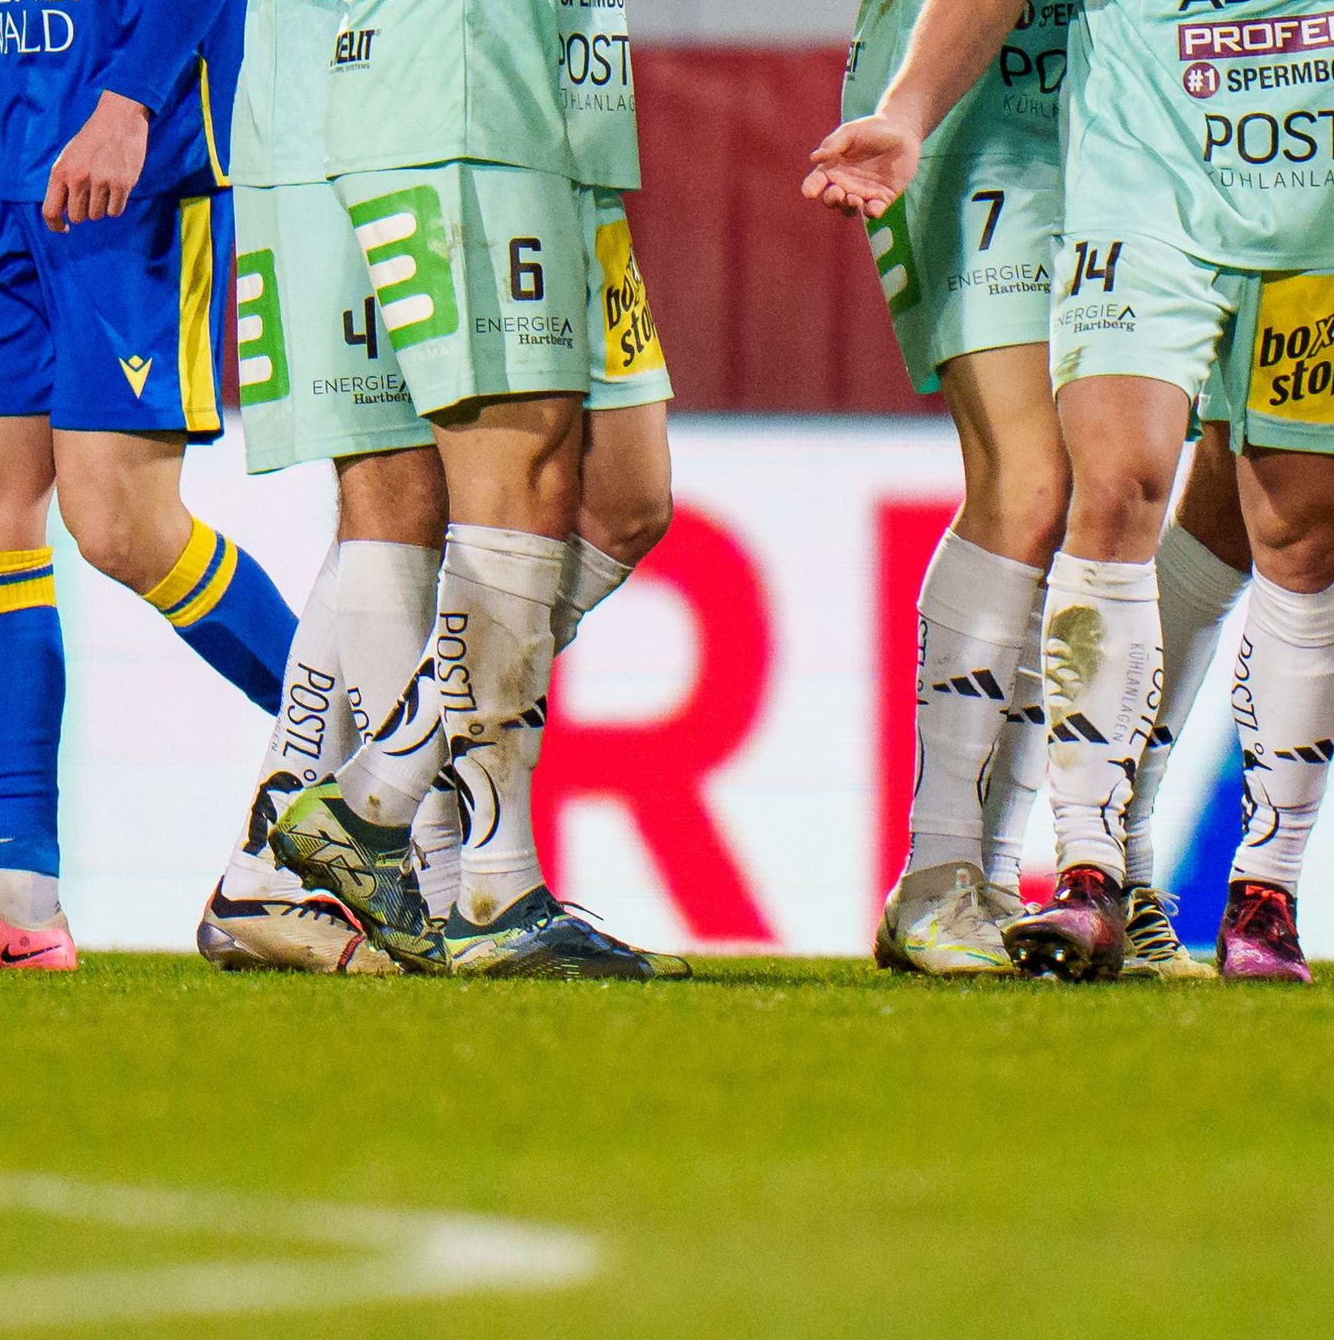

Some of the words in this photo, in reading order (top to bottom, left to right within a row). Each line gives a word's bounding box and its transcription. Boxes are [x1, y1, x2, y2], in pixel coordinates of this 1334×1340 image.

[1187, 68, 1217, 93] #1
[971, 190, 1006, 252] 7
[509, 237, 545, 302] 6
[988, 279, 1051, 296] Hartberg
[1070, 241, 1124, 297] 14
[343, 295, 378, 360] 4
[518, 332, 574, 350] Hartberg
[1073, 318, 1137, 334] Hartberg
